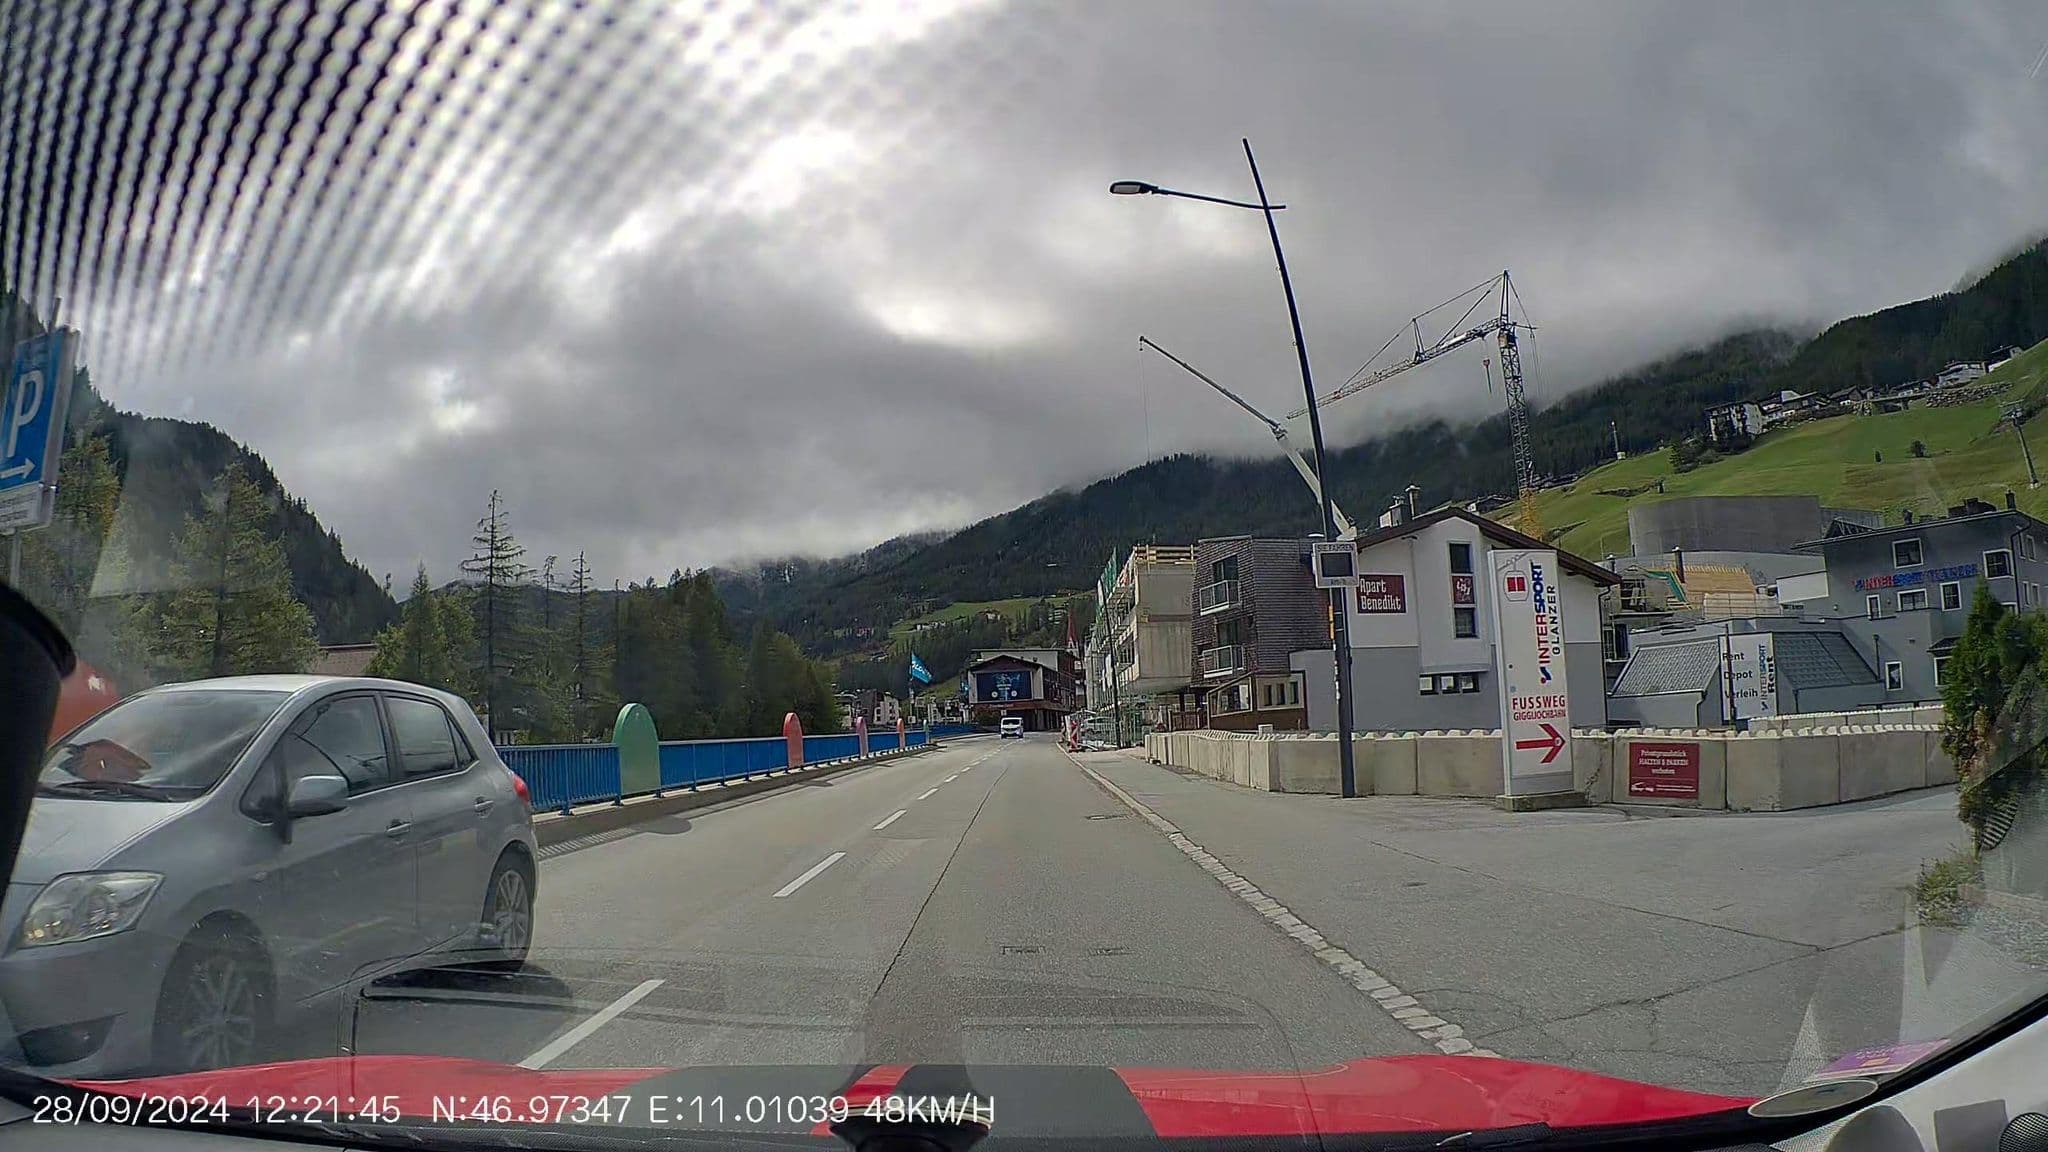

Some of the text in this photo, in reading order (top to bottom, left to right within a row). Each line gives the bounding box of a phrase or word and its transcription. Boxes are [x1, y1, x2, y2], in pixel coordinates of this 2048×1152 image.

[6, 370, 44, 458] P
[1359, 578, 1387, 595] Apart
[1360, 595, 1402, 610] Benedikt
[1530, 562, 1550, 664] INTERSPORT
[1547, 585, 1560, 655] GLANZER
[1766, 655, 1775, 693] Rent
[1512, 695, 1566, 710] FUSSWEG
